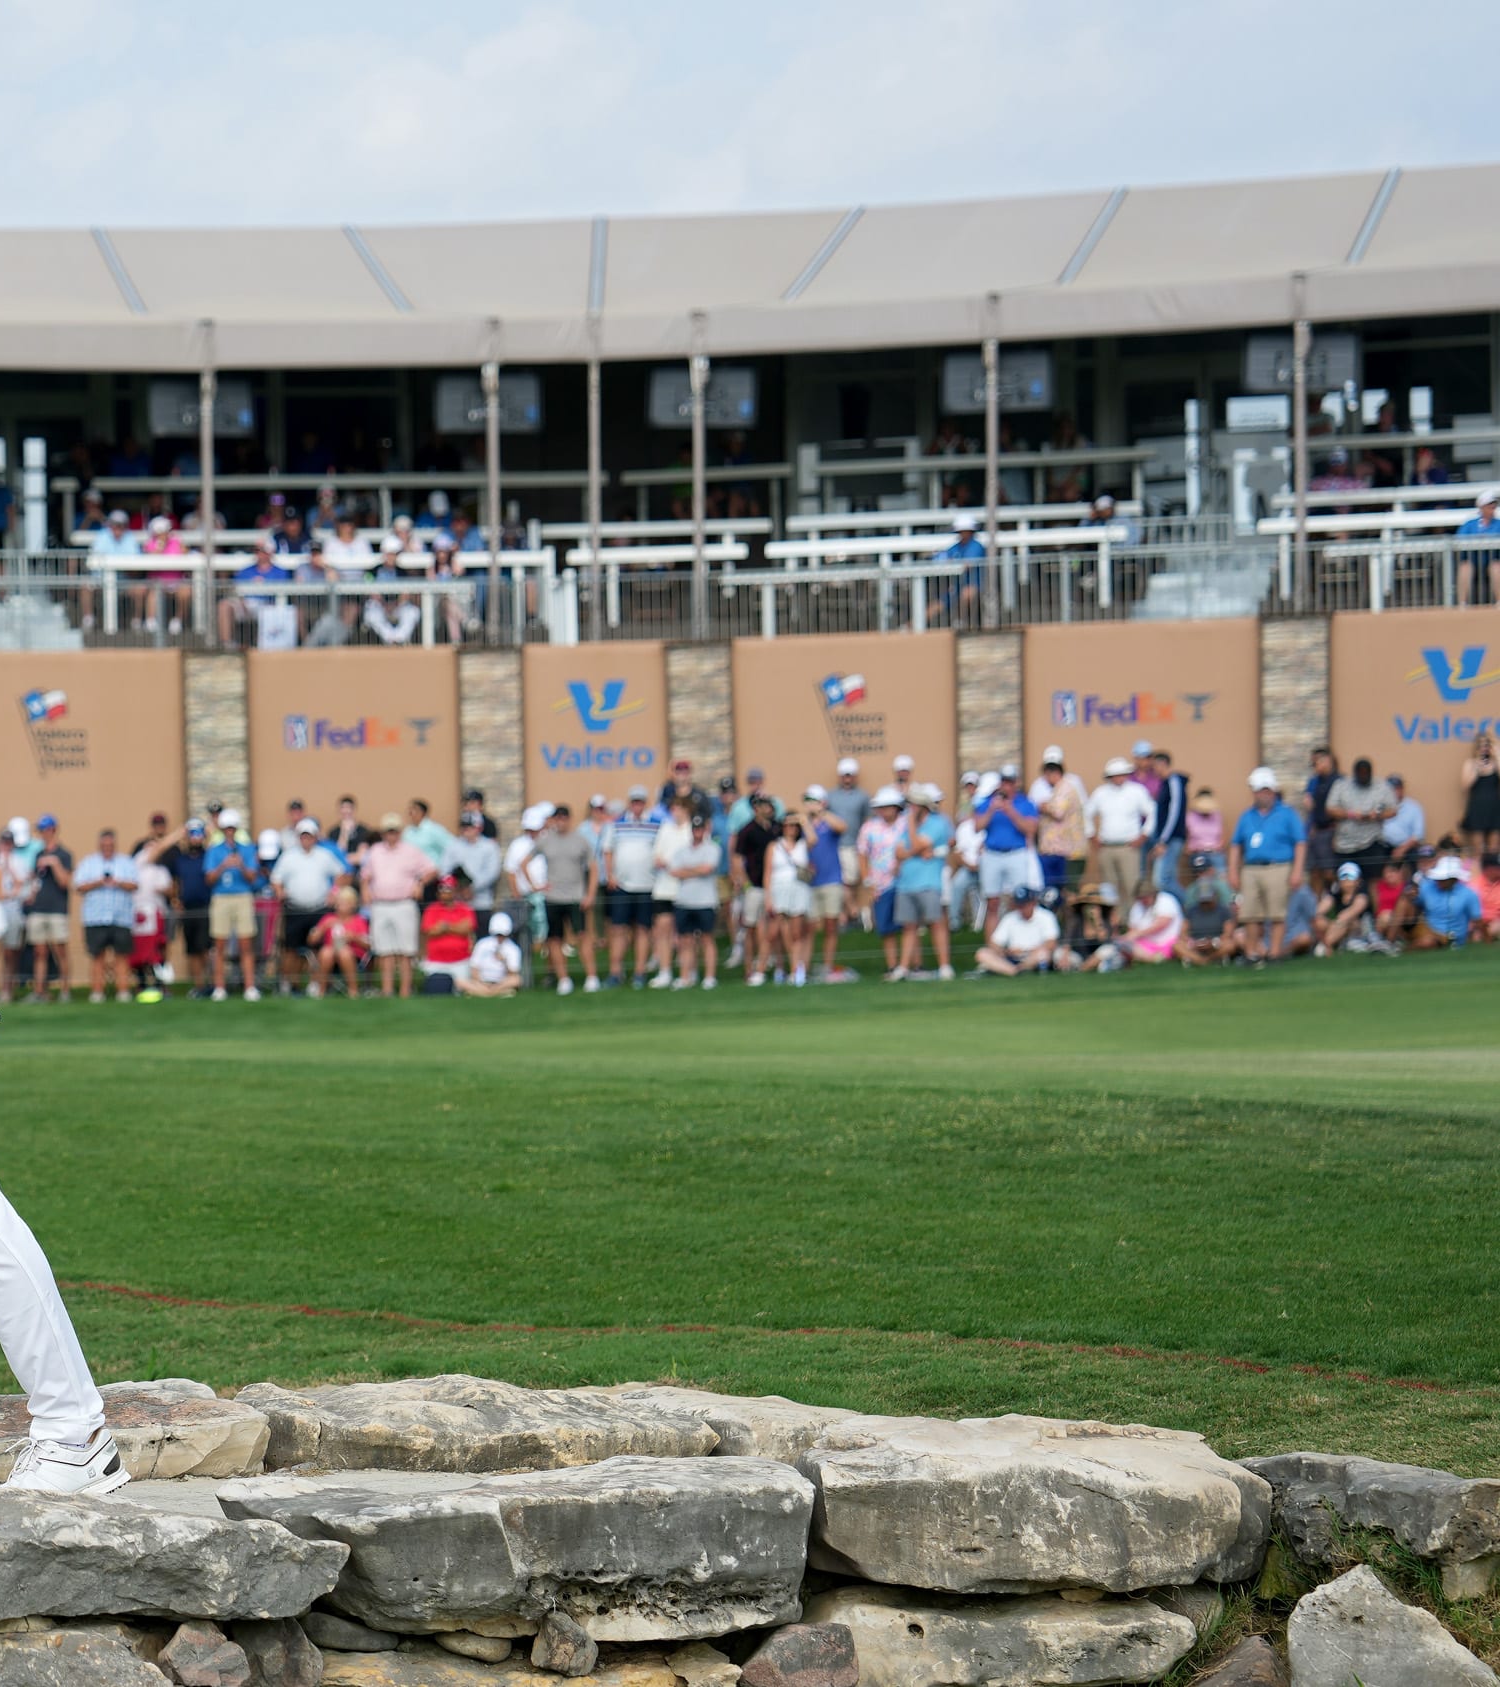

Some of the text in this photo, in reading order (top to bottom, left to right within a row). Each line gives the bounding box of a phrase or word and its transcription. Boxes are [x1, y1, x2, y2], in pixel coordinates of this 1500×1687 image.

[1084, 692, 1176, 725] FedEx
[314, 718, 402, 750] FedEx
[1393, 713, 1500, 742] Valer
[540, 743, 655, 770] Valero
